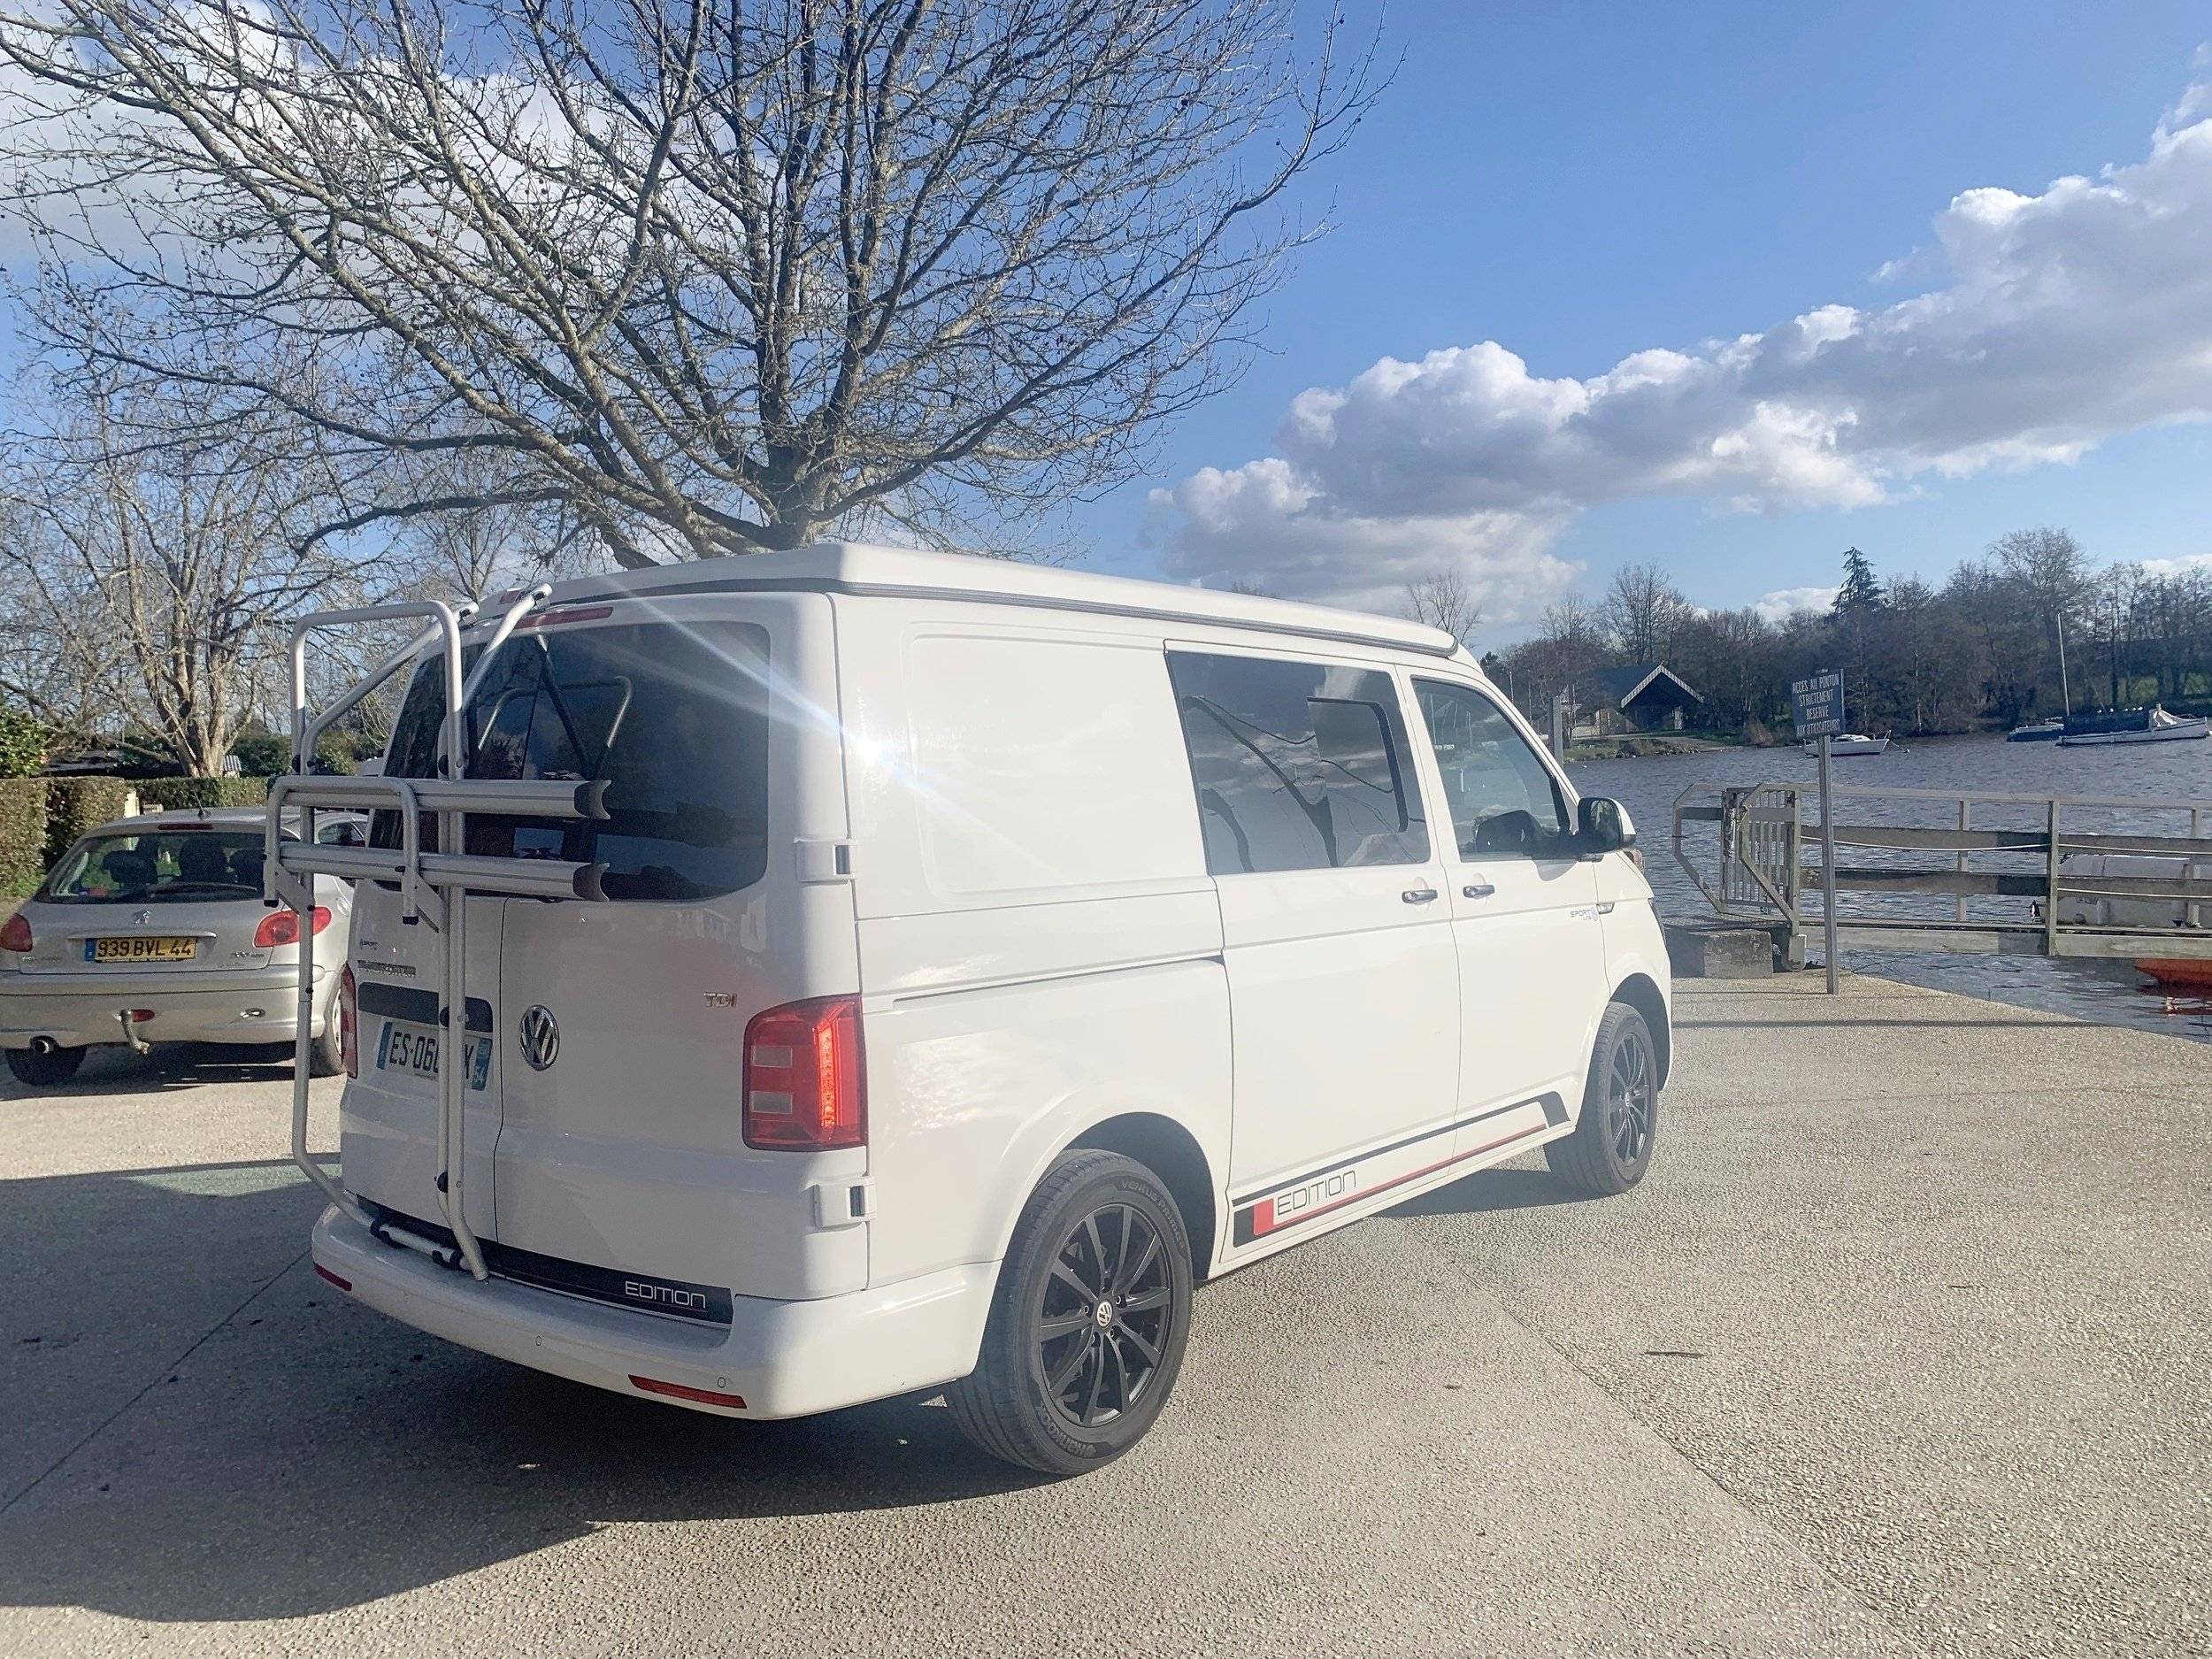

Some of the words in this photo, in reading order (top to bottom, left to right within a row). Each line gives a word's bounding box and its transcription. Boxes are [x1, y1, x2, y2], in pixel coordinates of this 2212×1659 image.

[1793, 680, 1808, 694] ACCES
[1810, 679, 1817, 689] AU
[1819, 674, 1839, 687] PONTON
[1799, 689, 1833, 706] STRICTEMENT
[97, 941, 130, 956] 939
[134, 940, 165, 956] BVL
[170, 939, 191, 955] 44
[703, 992, 737, 1007] TDI
[1278, 1171, 1356, 1216] EDITION
[626, 1281, 706, 1309] EDITION
